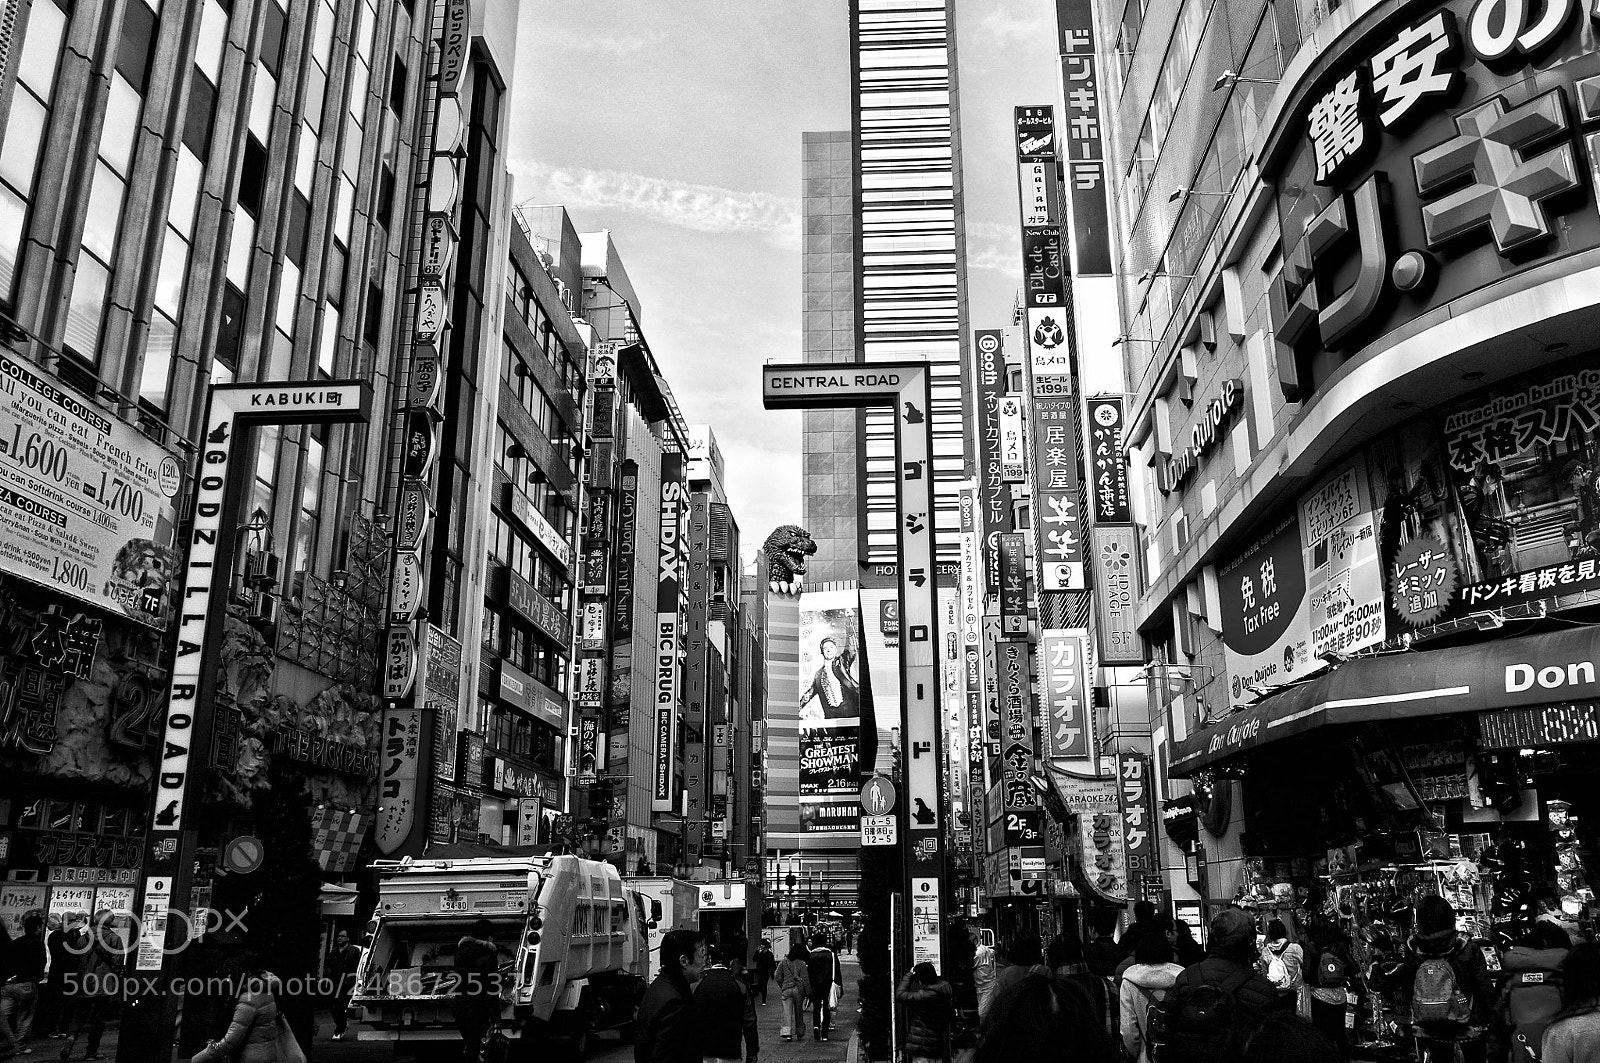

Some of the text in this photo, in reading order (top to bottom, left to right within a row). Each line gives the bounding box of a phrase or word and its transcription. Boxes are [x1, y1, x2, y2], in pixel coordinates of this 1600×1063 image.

[1033, 165, 1047, 213] Garam
[424, 265, 440, 273] 6F
[1029, 245, 1045, 291] Elle de
[1045, 238, 1060, 279] Castle
[416, 361, 435, 393] 虎の子
[979, 334, 999, 385] Booth
[0, 359, 110, 434] COLLEGE COURSE
[771, 374, 900, 389] CENTRAL ROAD
[1036, 376, 1067, 384] 生ビール
[1444, 374, 1577, 433] Attraction built
[20, 391, 42, 413] you
[46, 407, 67, 427] can
[71, 422, 88, 440] eat
[96, 431, 132, 465] French
[135, 457, 158, 480] fries
[8, 423, 68, 482] 1,600
[65, 475, 80, 490] yen
[162, 463, 176, 479] 120
[1006, 469, 1022, 477] 199
[1045, 425, 1069, 488] 居楽屋
[10, 473, 92, 516] can Softdrink course
[16, 496, 65, 527] COURSE
[96, 471, 143, 522] 1,700
[141, 516, 154, 529] yen
[659, 481, 682, 583] SHIDAX
[51, 556, 88, 591] 1,800
[1394, 549, 1446, 579] レーザー
[1397, 566, 1448, 597] ギミック
[1461, 558, 1600, 606] 「ドンキ看板を見
[144, 594, 159, 612] 7F
[1107, 573, 1121, 618] STAGE
[1240, 556, 1278, 613] 免税
[1408, 590, 1438, 614] 追加
[160, 449, 227, 790] GODZILLA ROAD
[903, 459, 931, 760] ゴジラロード
[1243, 601, 1280, 637] Tax Free
[1112, 631, 1131, 645] 5F
[388, 640, 405, 680] かっぱ
[658, 622, 674, 703] BIC DRUG
[1241, 662, 1278, 689] Don Quijote
[1505, 660, 1596, 693] Don
[388, 684, 402, 693] B1
[1050, 640, 1080, 750] カラオケ
[404, 712, 419, 760] 大衆酒場
[583, 720, 596, 751] 海の家
[660, 725, 668, 758] CAMERA
[805, 744, 857, 759] GREATEST
[969, 725, 983, 763] 甘太郎
[1207, 717, 1260, 755] Don Quijote
[383, 717, 406, 799] トラノコ
[800, 753, 859, 770] SHOWMAN
[1003, 741, 1037, 809] 金の蔵
[658, 763, 667, 797] SHIDAX
[827, 778, 847, 788] 2.16
[819, 806, 858, 818] MARUHAN
[1064, 795, 1103, 804] KARAOKE
[1122, 757, 1148, 850] カラオケ
[1092, 812, 1116, 890] カラオケ
[1128, 855, 1149, 870] B1
